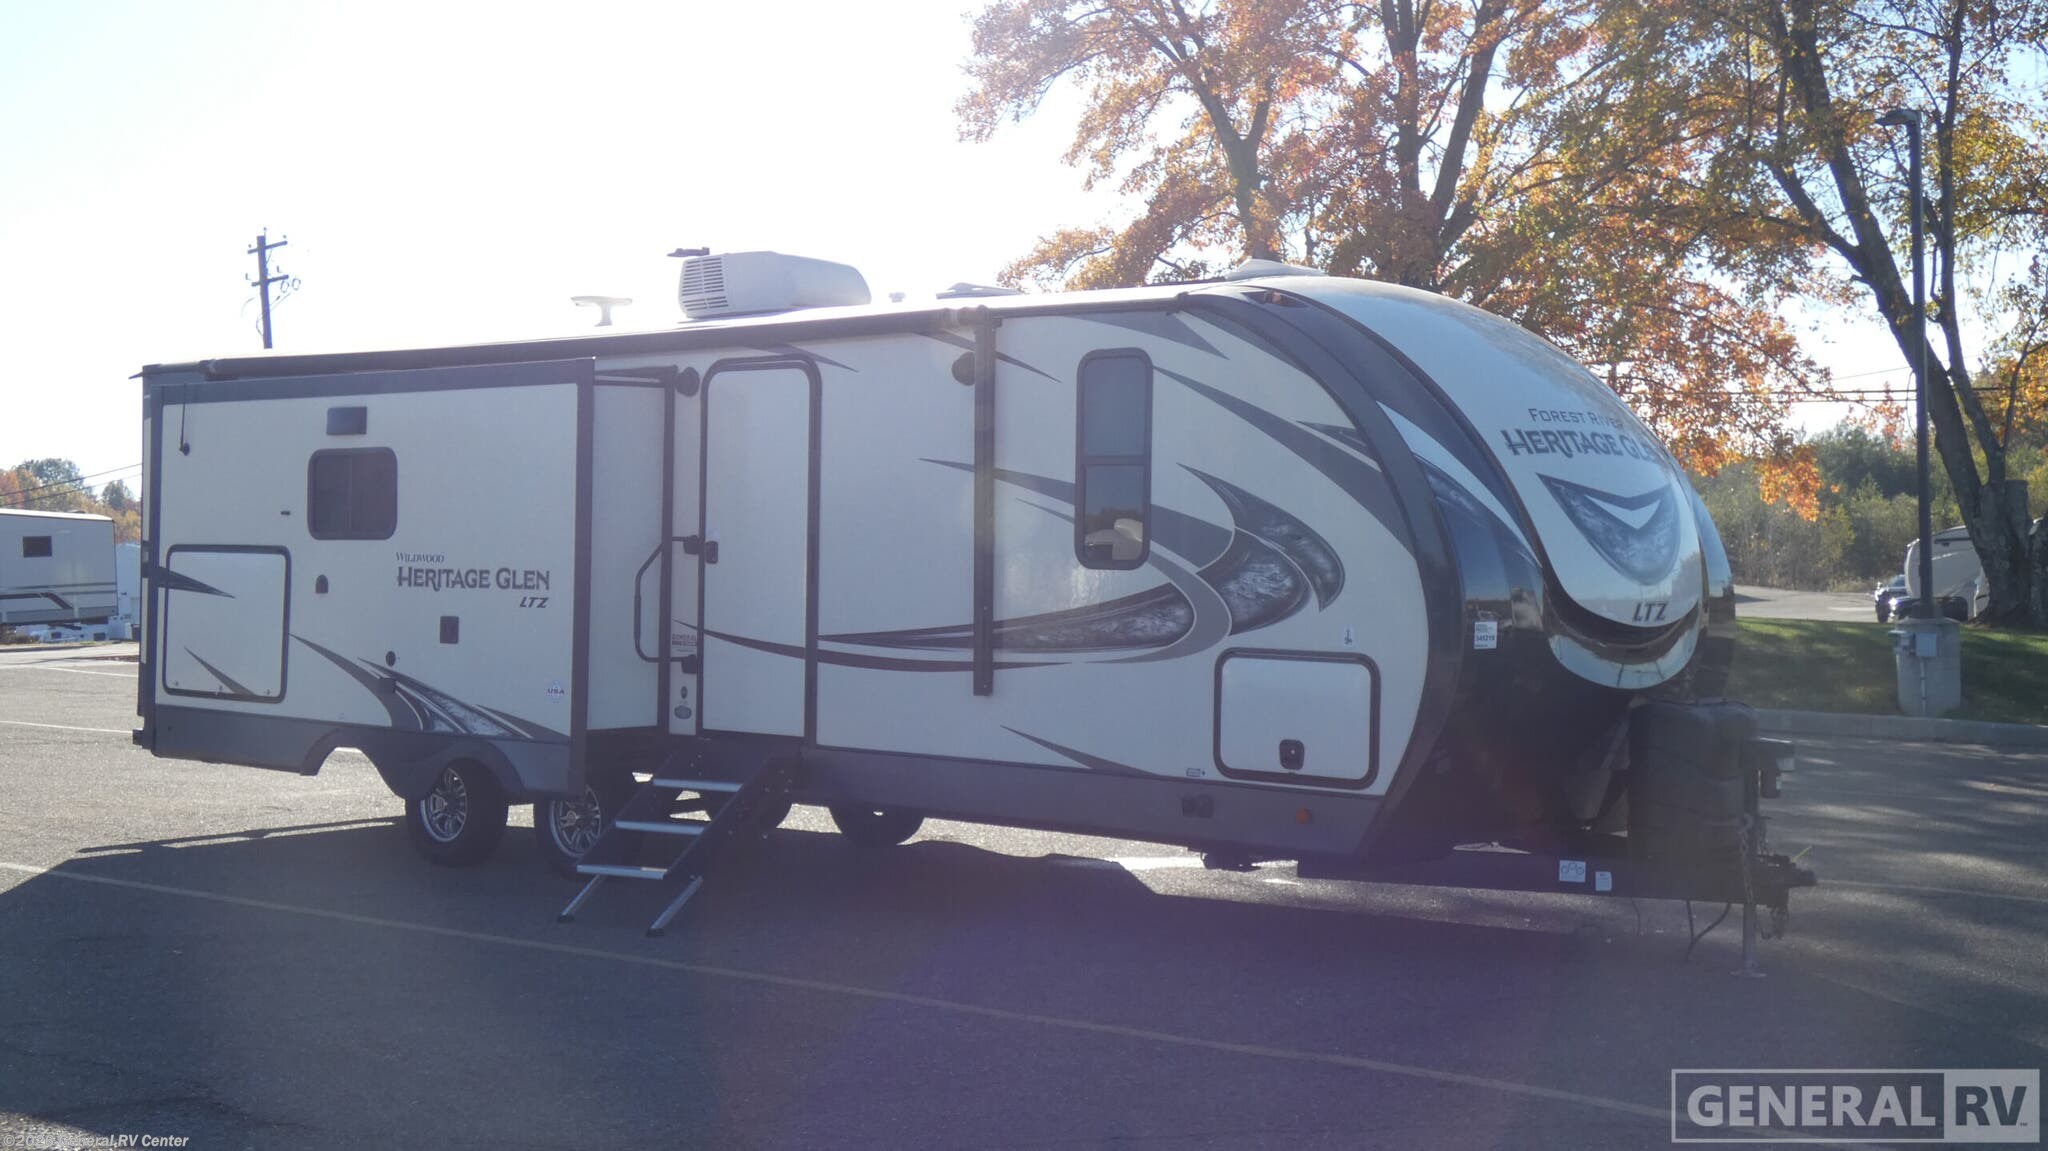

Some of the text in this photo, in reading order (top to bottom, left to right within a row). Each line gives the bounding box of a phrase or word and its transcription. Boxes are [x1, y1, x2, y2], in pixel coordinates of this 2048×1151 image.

[1528, 408, 1584, 423] FOREST
[1500, 428, 1623, 459] HERITAGE
[395, 551, 445, 563] WILDWOOD
[397, 566, 550, 592] HERITAGE GLEN
[519, 596, 549, 609] LTZ
[1632, 601, 1670, 622] LTZ
